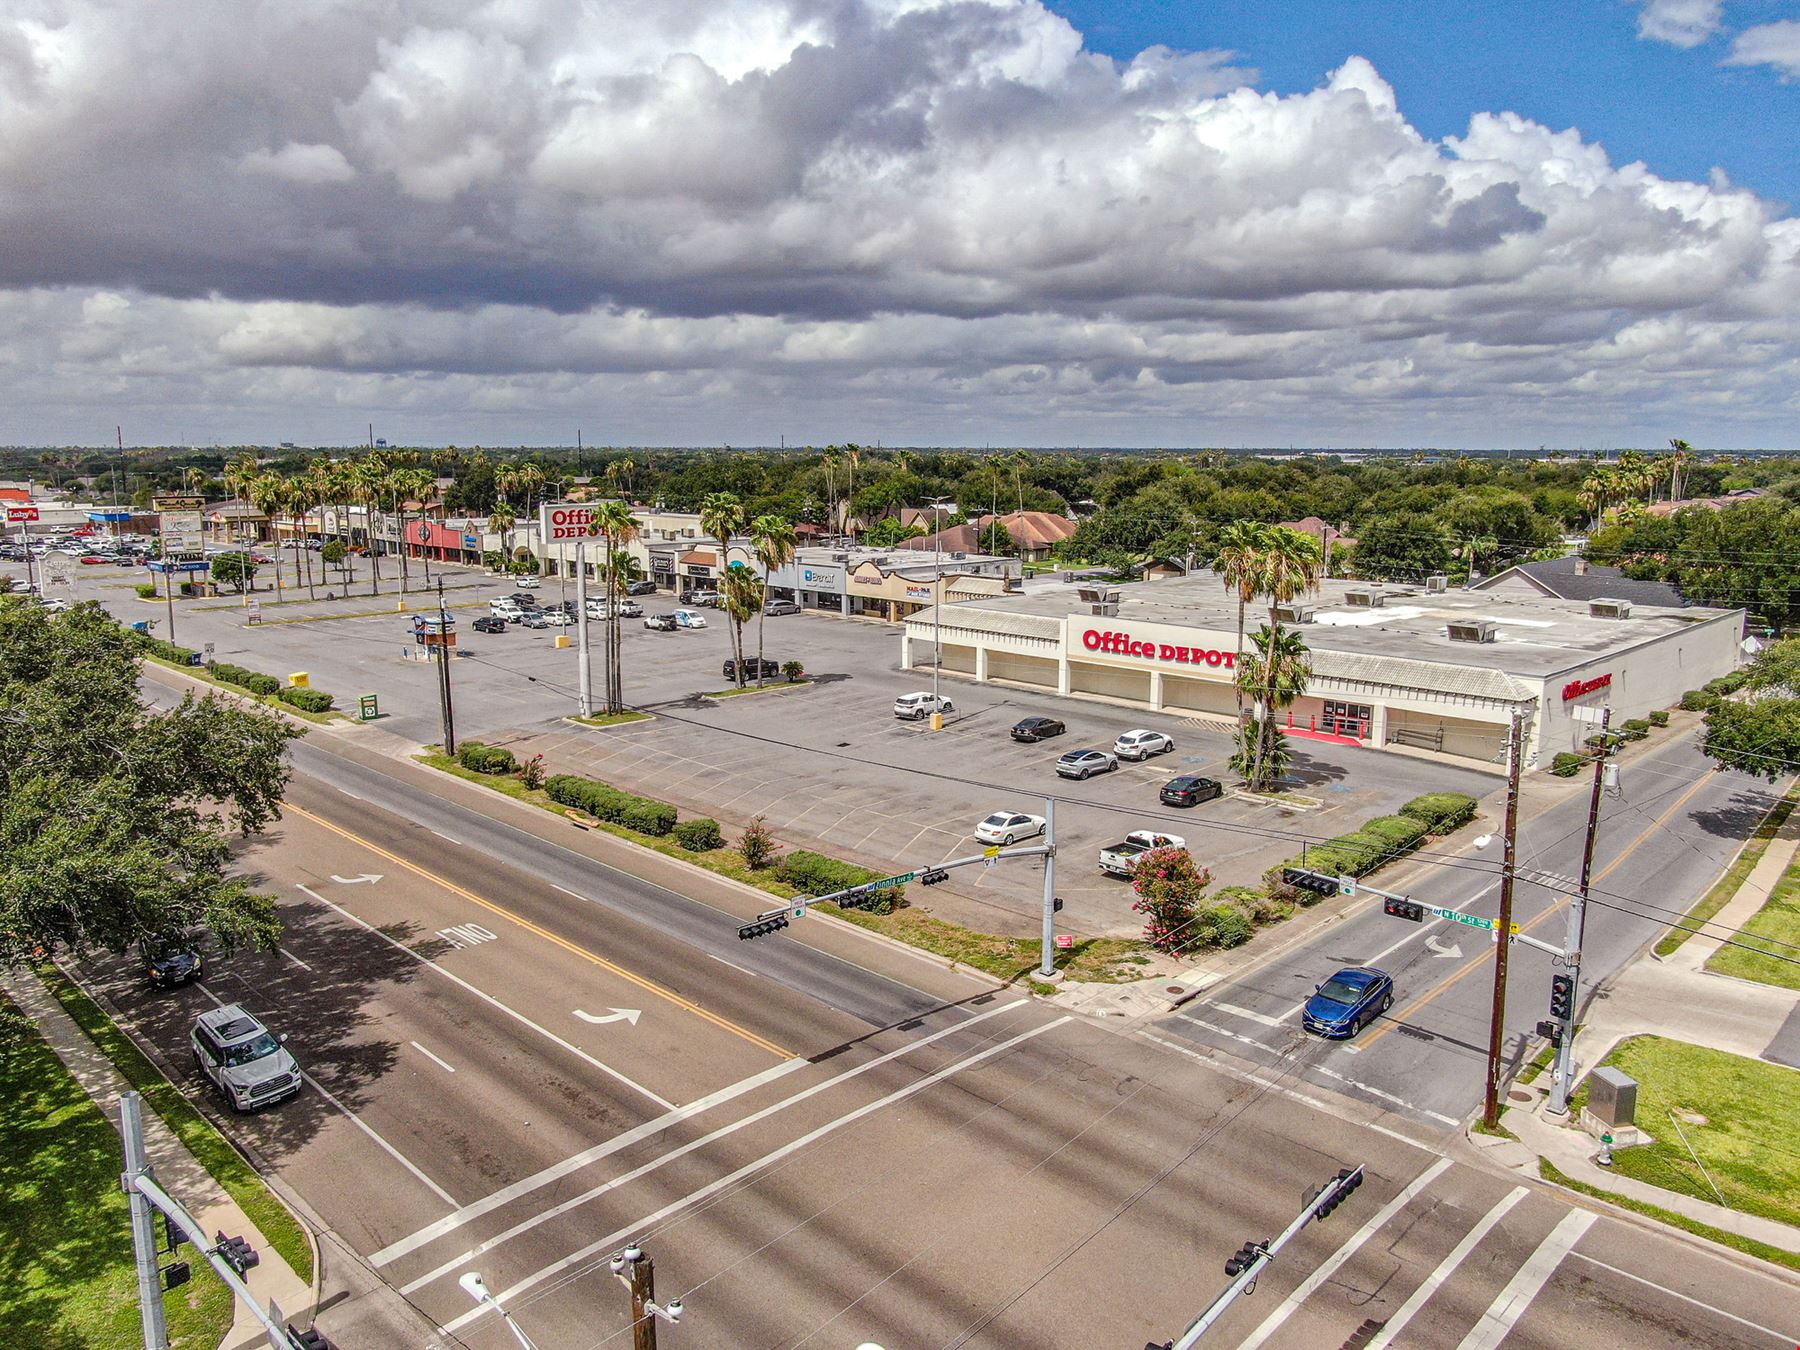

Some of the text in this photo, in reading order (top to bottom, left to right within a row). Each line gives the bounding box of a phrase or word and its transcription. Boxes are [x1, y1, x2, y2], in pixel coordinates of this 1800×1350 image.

[552, 508, 597, 526] Offi
[1082, 629, 1238, 668] Office DEPOT
[435, 923, 498, 950] ONLY
